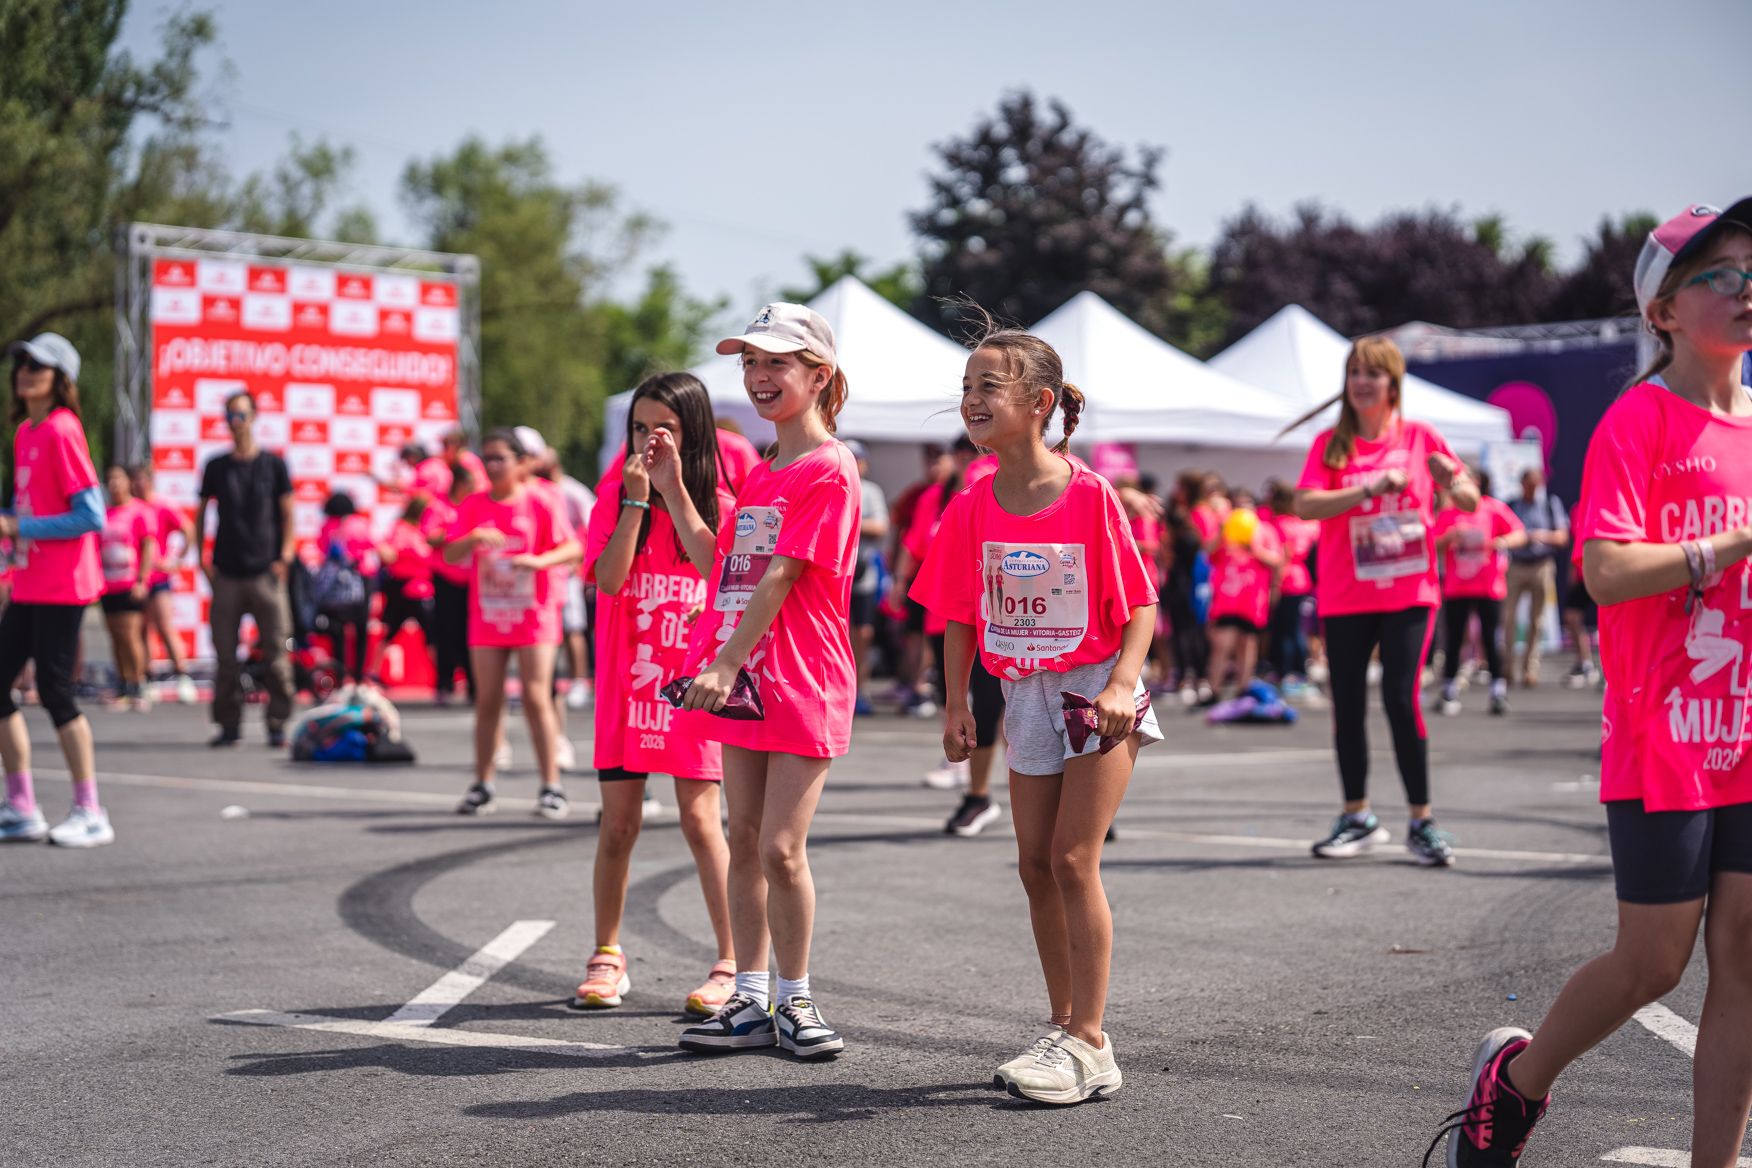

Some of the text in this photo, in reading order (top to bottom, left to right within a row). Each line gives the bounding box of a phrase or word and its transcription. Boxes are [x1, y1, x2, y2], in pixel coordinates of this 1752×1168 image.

[1660, 495, 1752, 543] CARR
[730, 555, 751, 572] 016
[1003, 560, 1046, 570] ASTURIANA
[1005, 596, 1047, 615] 016
[661, 611, 689, 649] DE
[1014, 619, 1036, 627] 2303
[628, 701, 674, 732] UJE
[1669, 697, 1752, 743] MUJE
[640, 734, 665, 750] 2026
